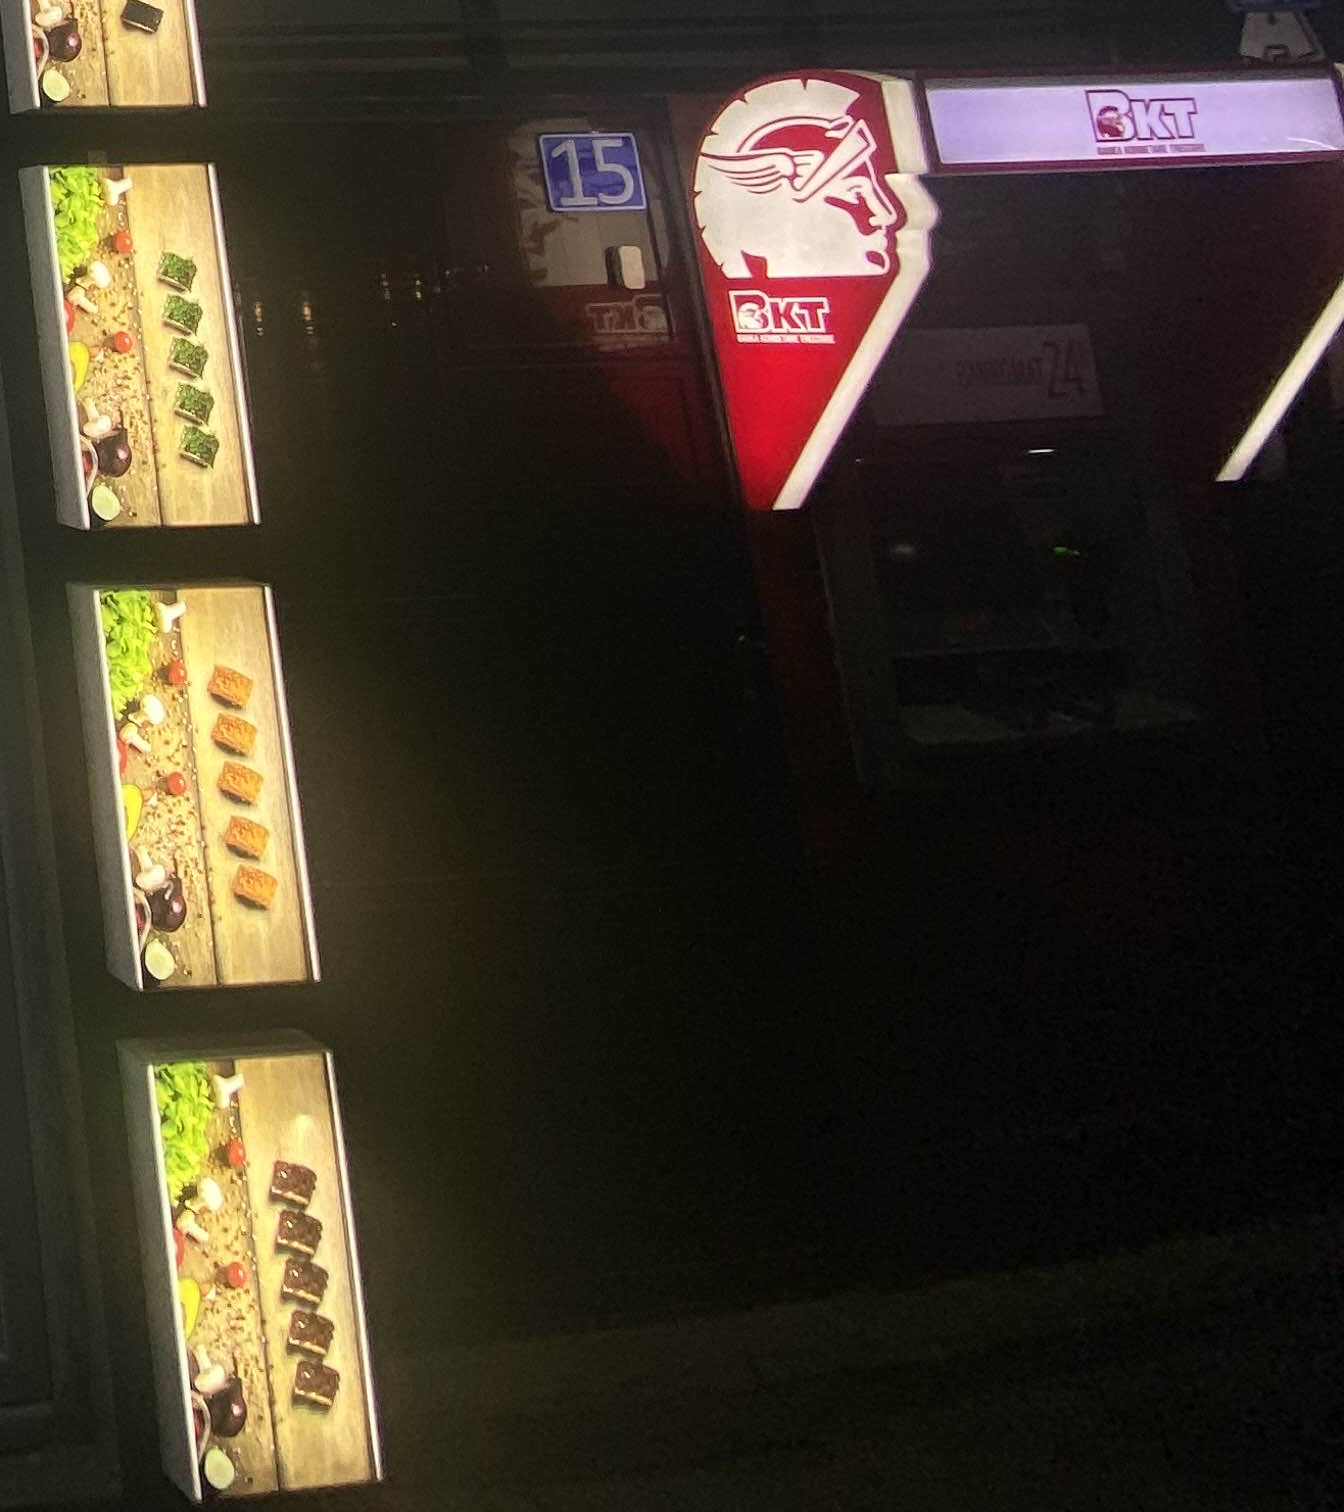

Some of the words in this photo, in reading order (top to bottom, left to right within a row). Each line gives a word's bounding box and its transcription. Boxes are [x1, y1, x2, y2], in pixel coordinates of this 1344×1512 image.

[1085, 89, 1198, 142] BKT
[551, 138, 635, 207] 15
[728, 290, 830, 334] BKT
